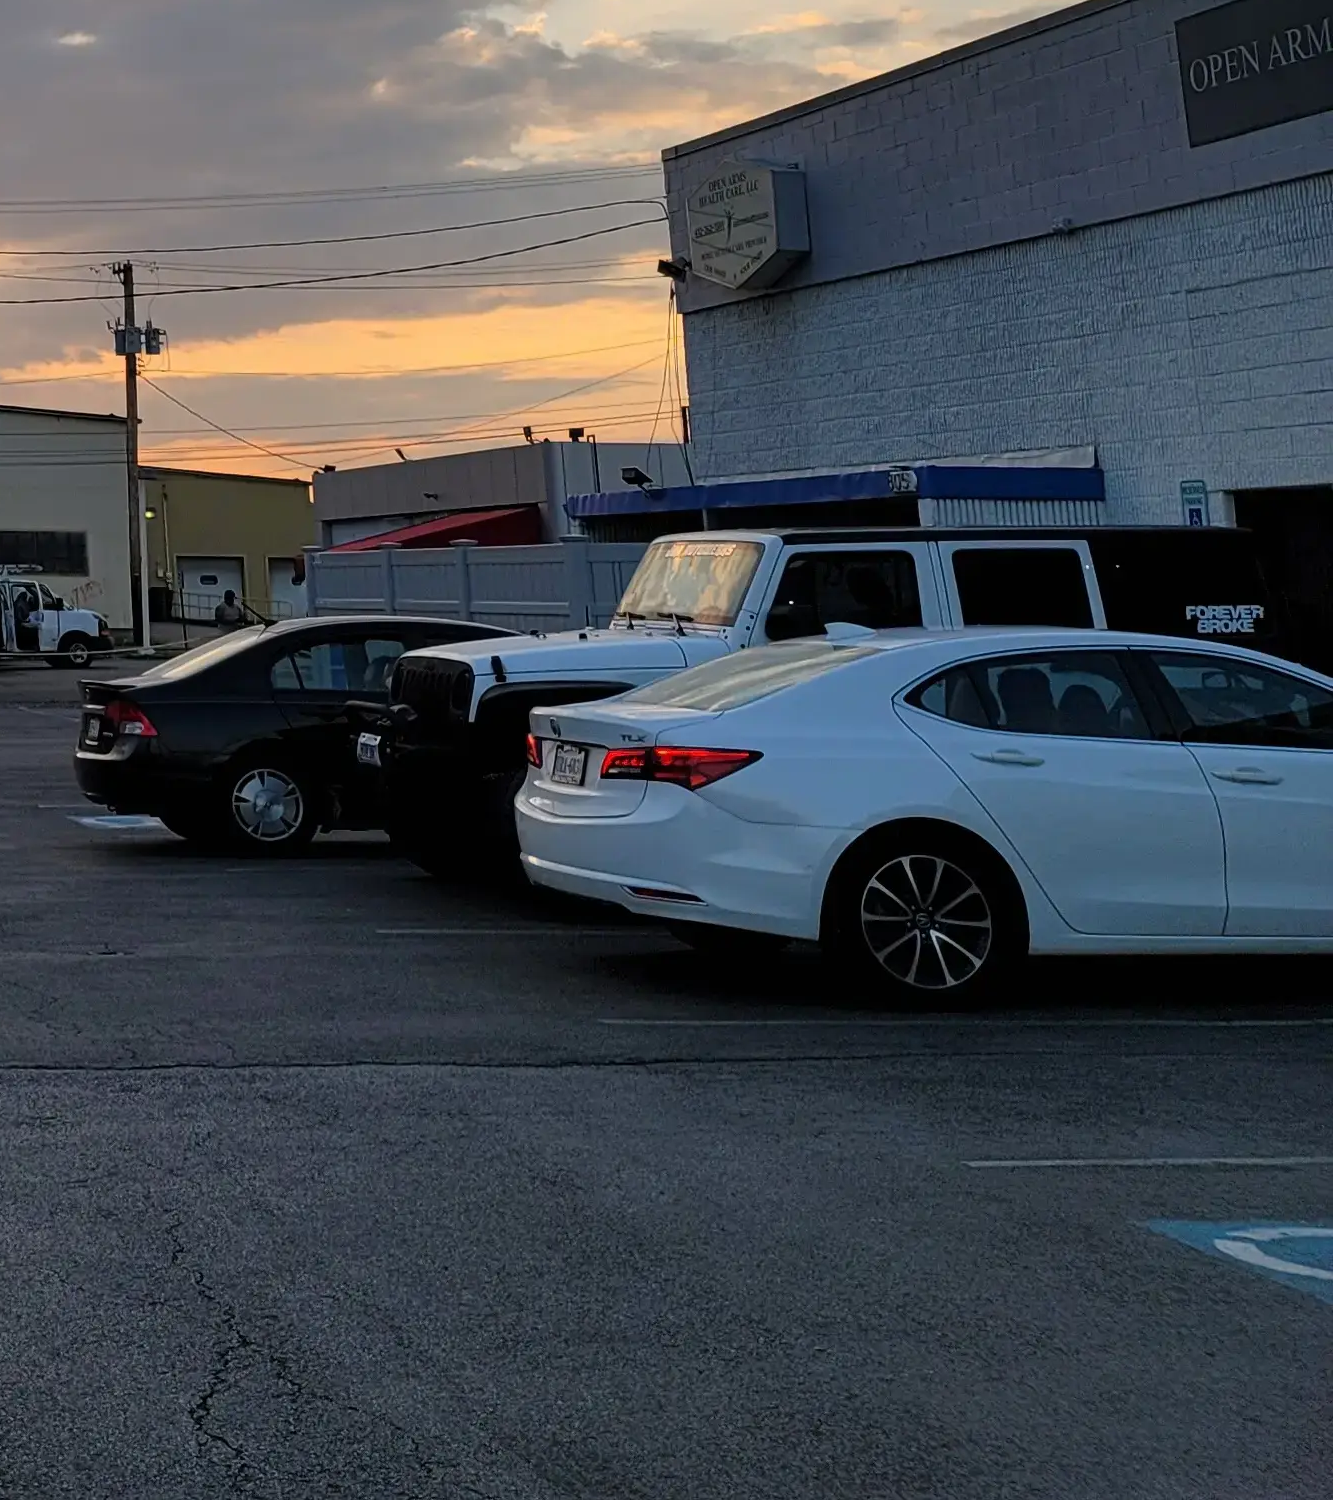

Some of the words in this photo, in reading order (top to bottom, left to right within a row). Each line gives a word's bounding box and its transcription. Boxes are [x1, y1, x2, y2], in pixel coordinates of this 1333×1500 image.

[1190, 40, 1261, 92] OPEN
[708, 176, 727, 192] OPEN
[729, 171, 747, 184] ARMS
[699, 191, 724, 208] HEALTH
[746, 179, 759, 192] LLC
[1185, 604, 1265, 620] FOREVER
[1197, 619, 1255, 633] BROKE
[620, 733, 648, 743] TLX
